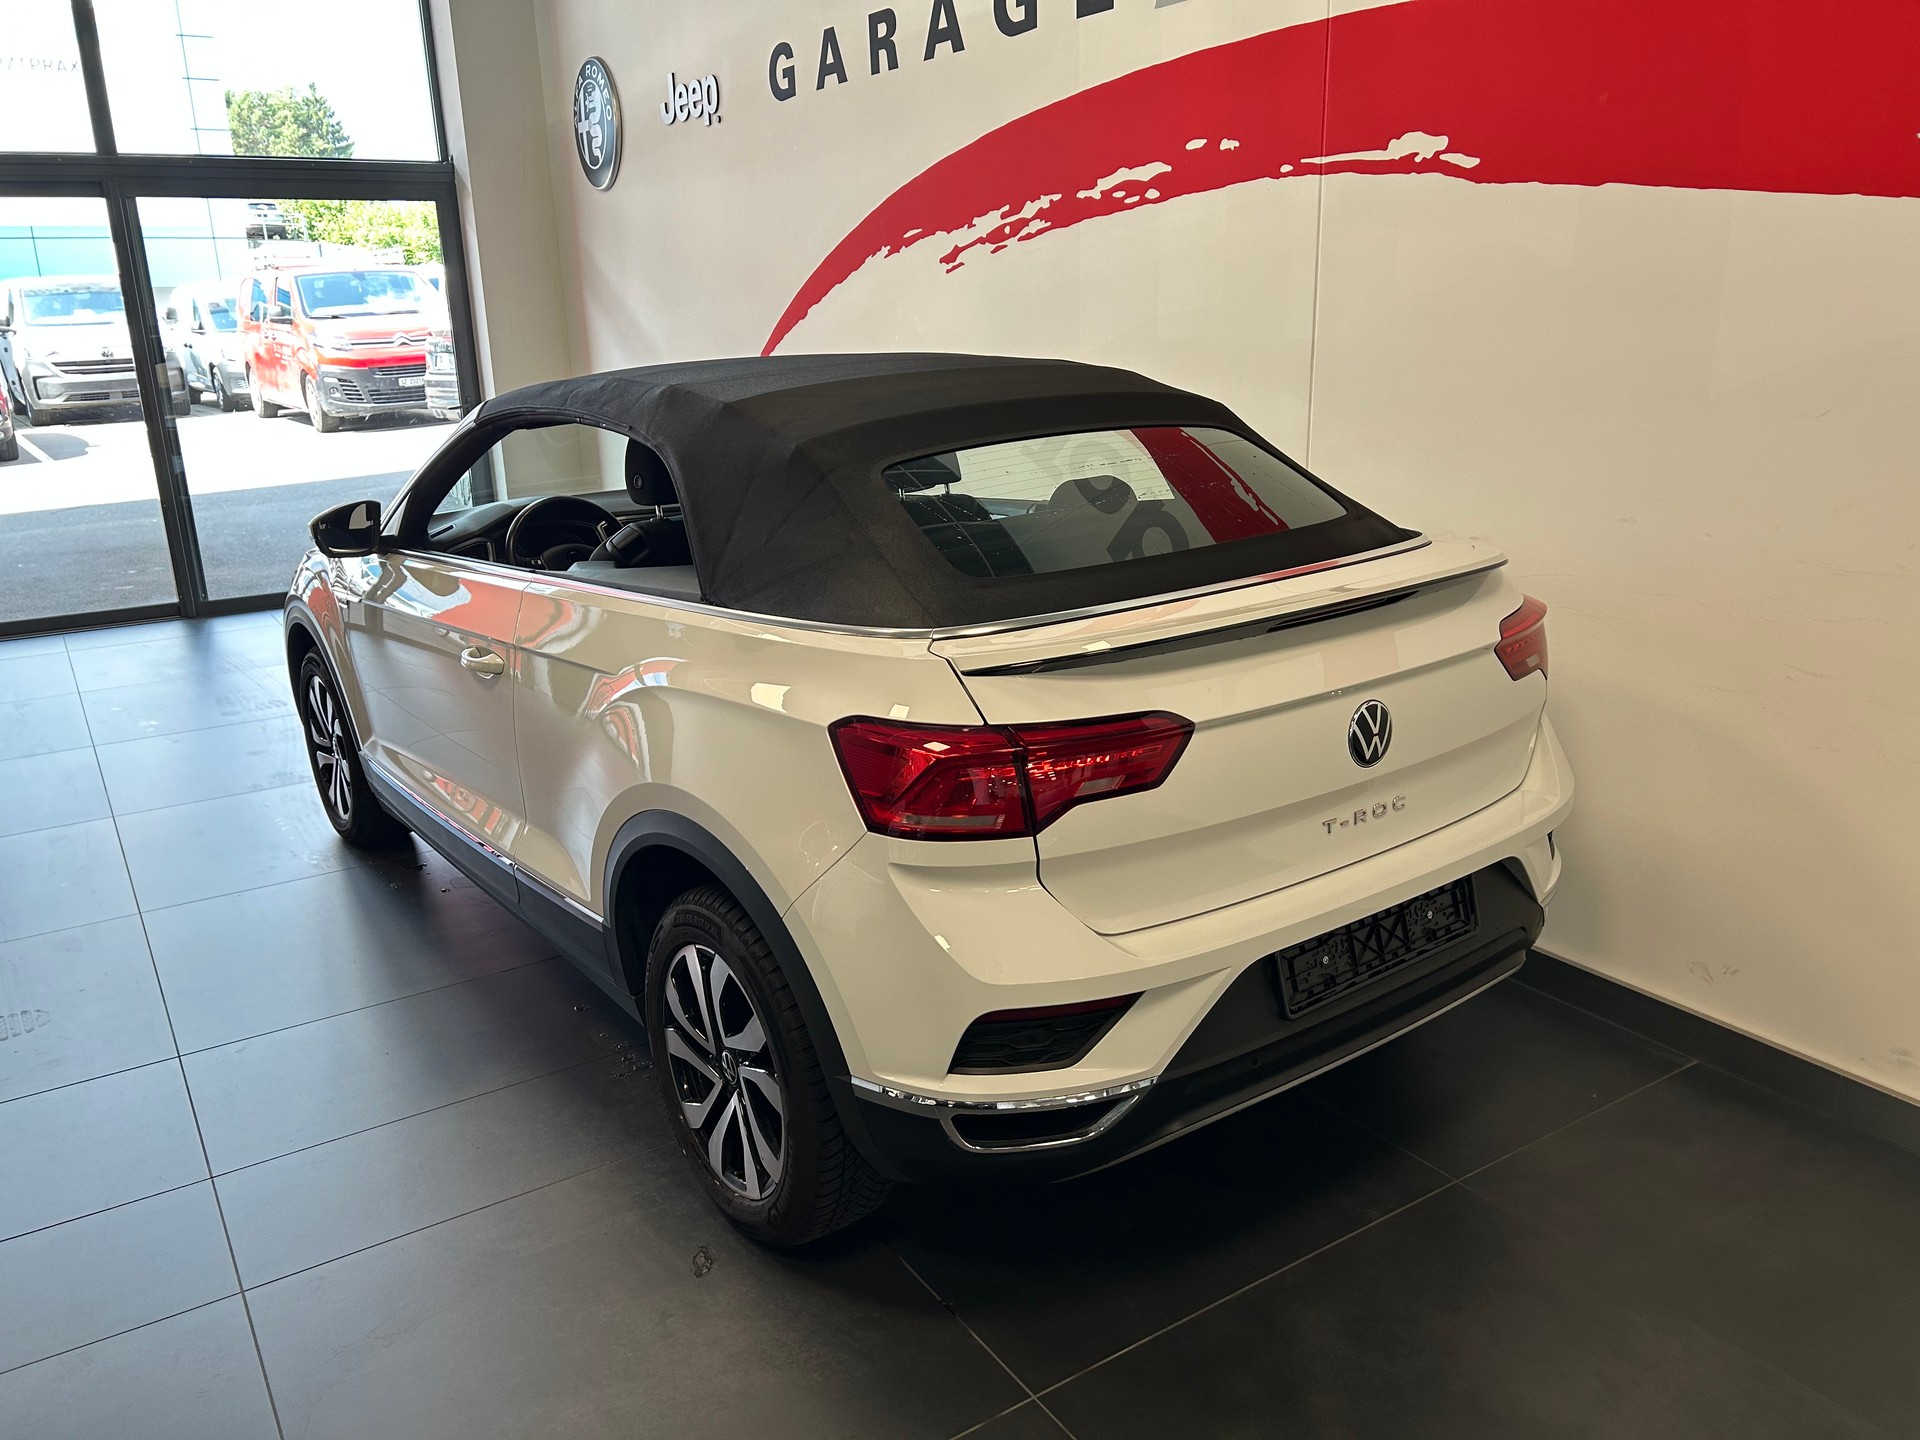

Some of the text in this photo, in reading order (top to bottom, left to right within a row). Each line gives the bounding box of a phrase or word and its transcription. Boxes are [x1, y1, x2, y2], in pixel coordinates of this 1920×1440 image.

[585, 64, 613, 121] ROMEO
[660, 72, 720, 126] Jeep
[1322, 794, 1407, 835] T-ROC
